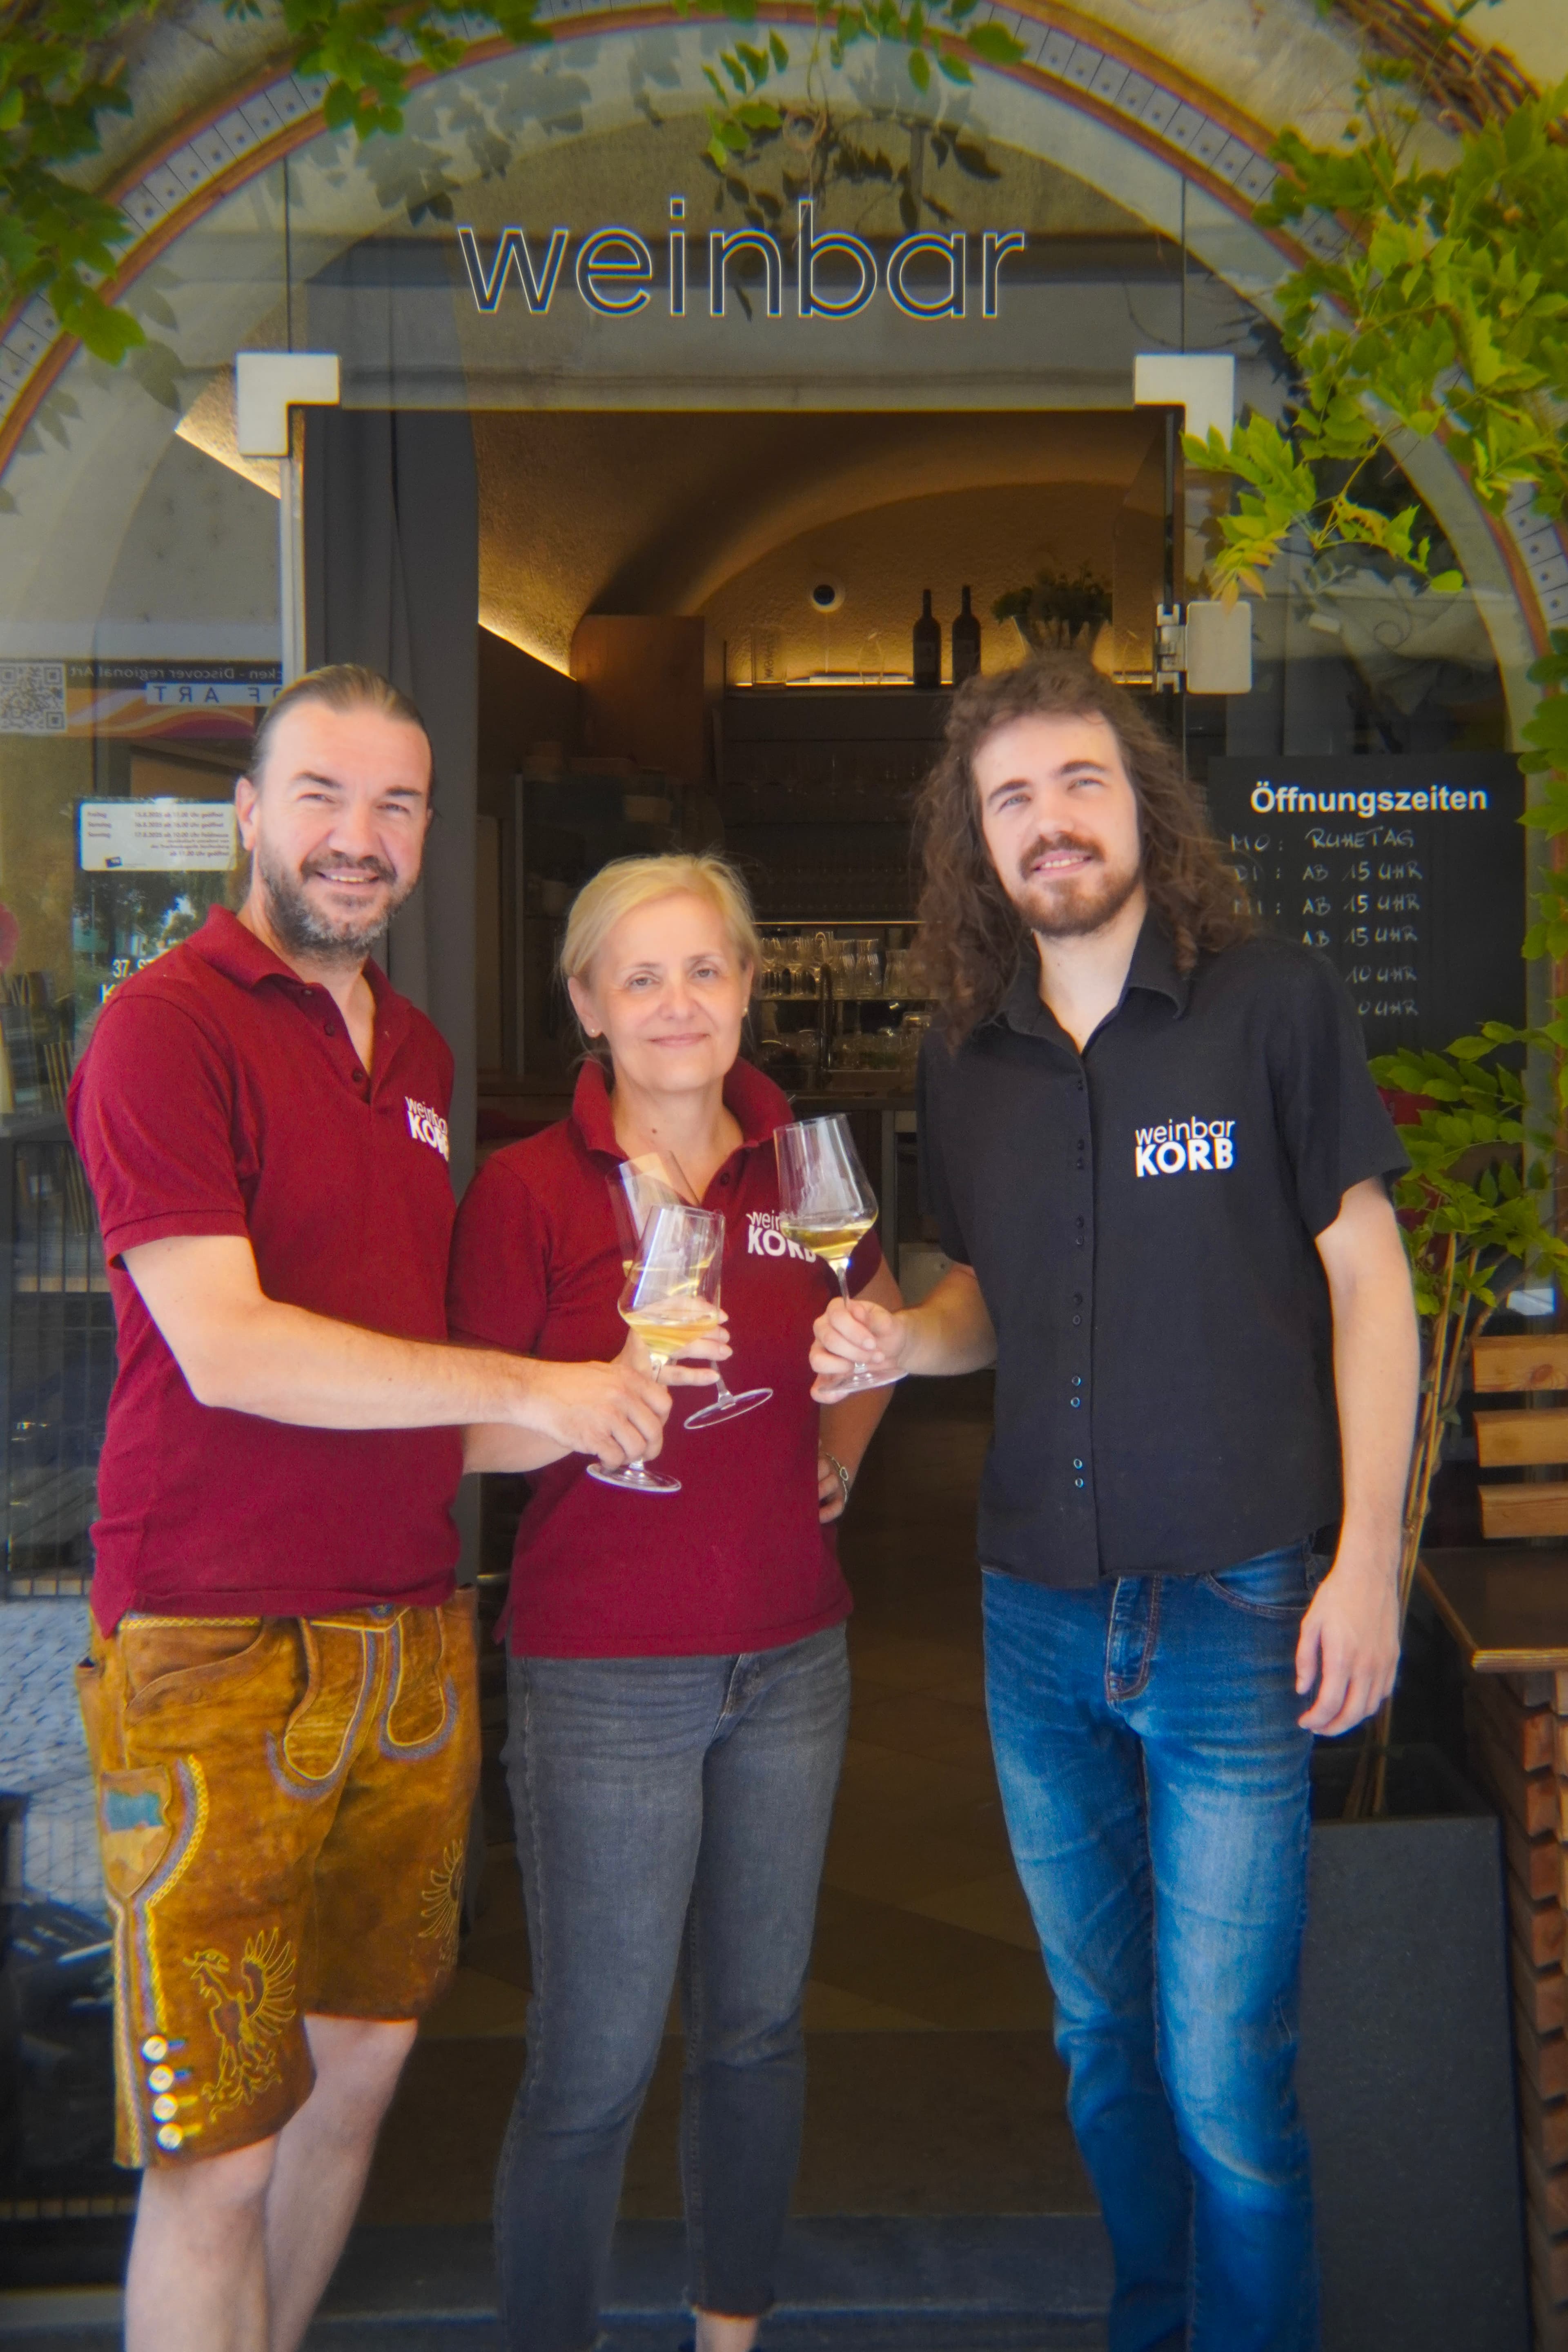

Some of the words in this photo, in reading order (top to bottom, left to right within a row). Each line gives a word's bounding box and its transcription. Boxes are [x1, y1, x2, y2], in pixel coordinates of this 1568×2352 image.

[458, 197, 1025, 320] weinbar
[1250, 781, 1486, 818] Öffnungszeiten
[1304, 825, 1414, 849] RUHETAG
[1302, 863, 1329, 881] AB
[1342, 861, 1370, 882] 15
[1378, 860, 1423, 881] UHR
[1302, 897, 1331, 916] AB
[1343, 894, 1369, 914] 15
[1376, 893, 1421, 913] UHR
[1302, 930, 1330, 947] AB
[1345, 927, 1370, 947] 15
[1374, 924, 1418, 943] UHR
[1345, 965, 1372, 984] 10
[1376, 965, 1417, 982] UHR
[1358, 1000, 1371, 1016] 0
[1374, 998, 1419, 1017] UHR
[404, 1096, 448, 1135] weinba
[1135, 1116, 1236, 1146] weinbar
[1135, 1137, 1233, 1177] KORB
